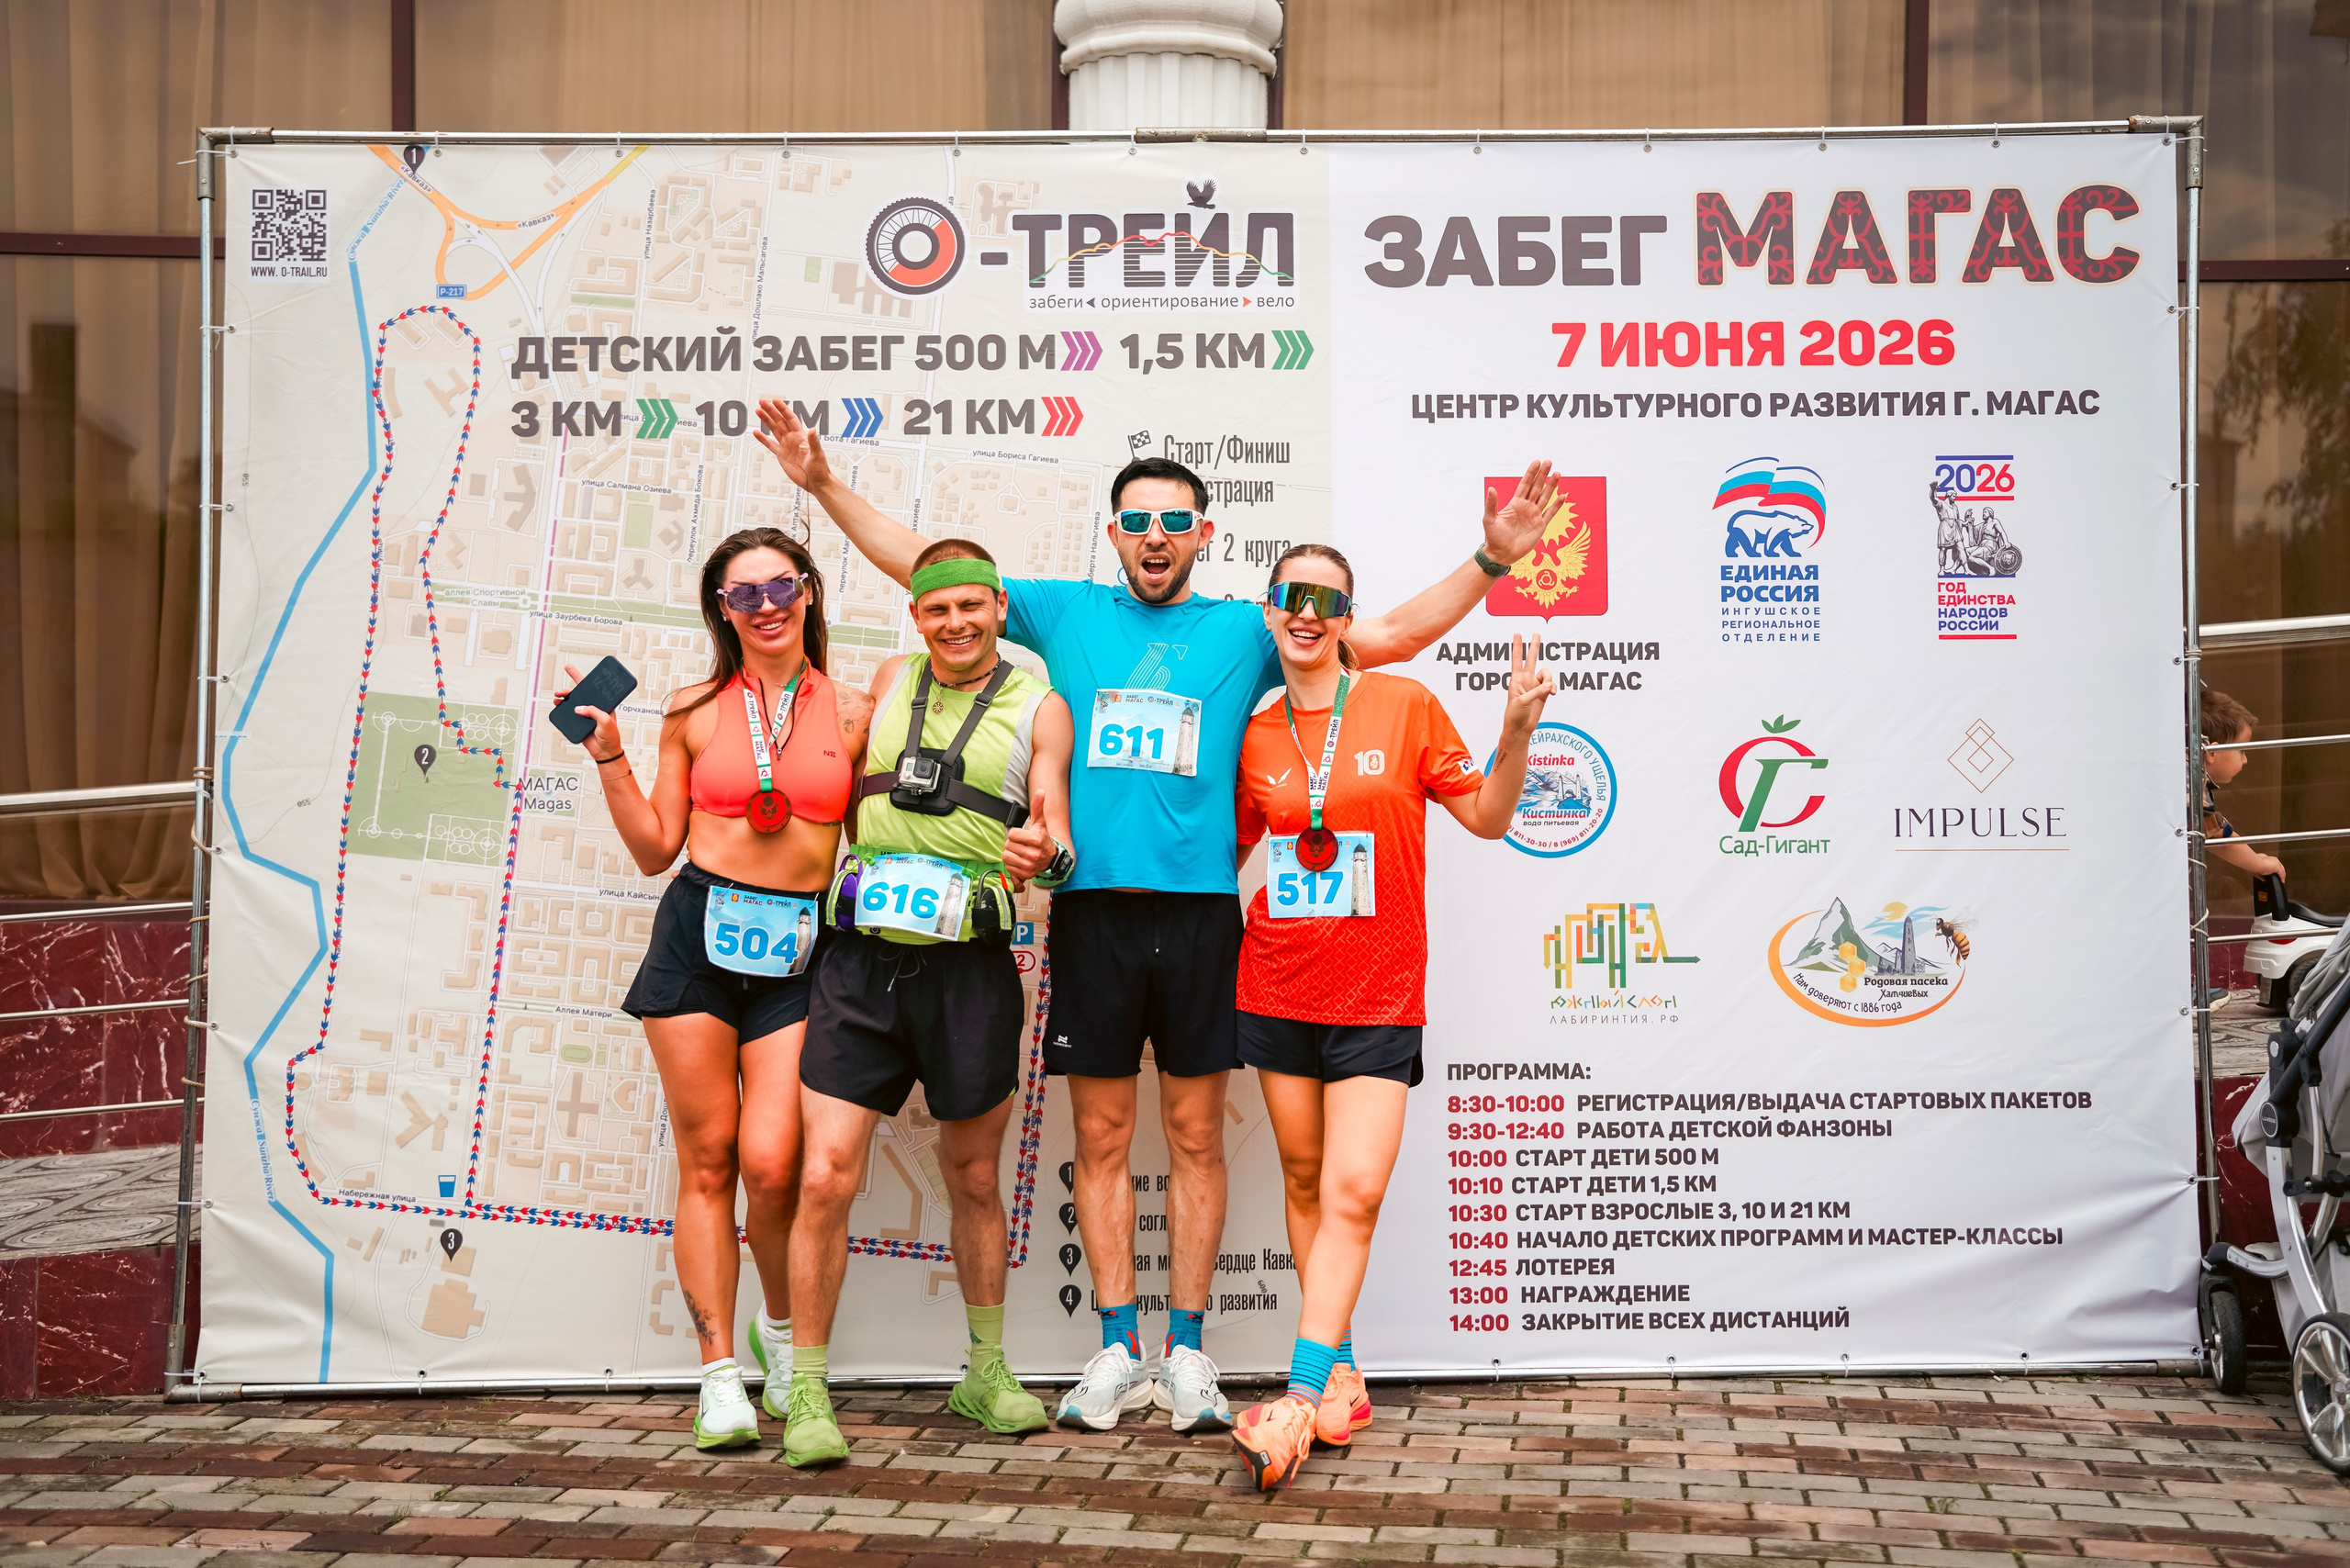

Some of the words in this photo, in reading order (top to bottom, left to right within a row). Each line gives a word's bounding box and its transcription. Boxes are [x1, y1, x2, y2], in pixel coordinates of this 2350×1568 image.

[411, 148, 417, 164] 1
[518, 212, 555, 230] «Кавказ»
[645, 189, 656, 235] Назарбаева
[1364, 215, 1668, 287] ЗАБЕГ
[1695, 185, 2140, 286] МАГАС
[251, 267, 278, 277] WWW.
[1029, 295, 1083, 309] забеги
[1102, 296, 1238, 310] ориентирование
[1257, 296, 1294, 308] вело
[511, 326, 741, 379] ДЕТСКИЙ
[753, 335, 905, 372] ЗАБЕГ
[915, 334, 1006, 371] 500
[1019, 334, 1055, 371] М
[1551, 322, 1586, 367] 7
[1600, 321, 1785, 367] ИЮНЯ
[1800, 319, 1955, 366] 2026
[1120, 333, 1184, 376] 1,5
[1196, 333, 1264, 370] КМ
[1412, 394, 1520, 423] ЦЕНТР
[1527, 392, 1762, 419] КУЛЬТУРНОГО
[1770, 391, 1944, 417] РАЗВИТИЯ
[1954, 391, 1979, 416] Г.
[1987, 389, 2099, 416] МАГАС
[511, 401, 540, 437] 3
[553, 401, 621, 436] КМ
[695, 400, 747, 436] 10
[904, 399, 952, 435] 21
[966, 399, 1035, 435] КМ
[973, 450, 995, 459] улица
[998, 451, 1026, 461] Бориса
[1028, 454, 1058, 464] Гагиева
[581, 479, 605, 489] улица
[607, 481, 642, 492] Салмана
[643, 485, 672, 494] Озиева
[694, 465, 704, 493] Бокова
[1935, 464, 2015, 493] 2026
[692, 494, 701, 524] Ахмеда
[1091, 511, 1101, 553] Нальгиева
[1224, 532, 1235, 562] 2
[1720, 565, 1818, 583] ЕДИНАЯ
[1720, 585, 1819, 602] РОССИЯ
[1938, 582, 1966, 594] ГОД
[1721, 607, 1820, 615] ИНГУШСКОЕ
[1938, 595, 2016, 607] ЕДИНСТВА
[530, 610, 553, 620] улица
[554, 611, 592, 623] Заурбека
[594, 615, 623, 626] Борова
[1938, 608, 2009, 619] НАРОДОВ
[1721, 620, 1820, 629] РЕГИОНАЛЬНОЕ
[1938, 621, 1999, 631] РОССИИ
[1721, 633, 1820, 643] ОТДЕЛЕНИЕ
[1456, 672, 1512, 690] ГОРО
[1560, 672, 1641, 690] МАГАС
[1099, 723, 1164, 759] 611
[421, 747, 429, 765] 2
[1353, 749, 1385, 776] 10
[1589, 757, 1606, 801] УЩЕЛЬЯ
[524, 798, 572, 812] Magas
[1522, 808, 1587, 819] Кистинка
[1895, 807, 2066, 837] IMPULSE
[1719, 835, 1830, 857] Сад-Гигант
[599, 889, 624, 898] улица
[1277, 871, 1343, 906] 517
[863, 881, 939, 919] 616
[1016, 924, 1029, 942] P
[715, 923, 798, 964] 504
[1863, 977, 1908, 988] Родовая
[1910, 977, 1948, 986] пасека
[1793, 972, 1808, 991] Нам
[1807, 987, 1851, 1011] доверяют
[1861, 1002, 1879, 1013] 1886
[1882, 1001, 1902, 1014] года
[555, 1006, 580, 1015] Аллея
[582, 1008, 612, 1018] Матери
[1448, 1063, 1591, 1081] ПРОГРАММА:
[1448, 1095, 1564, 1113] 8:30-10:00
[1577, 1092, 1845, 1114] РЕГИСТРАЦИЯ/ВЫДАЧА
[1850, 1092, 1986, 1109] СТАРТОВЫХ
[1991, 1092, 2092, 1108] ПАКЕТОВ
[1448, 1122, 1564, 1140] 9:30-12:40
[1577, 1121, 1664, 1138] РАБОТА
[1668, 1115, 1772, 1141] ДЕТСКОЙ
[1776, 1119, 1892, 1137] ФАНЗОНЫ
[1448, 1149, 1507, 1167] 10:00
[1516, 1149, 1587, 1167] СТАРТ
[1591, 1148, 1650, 1170] ДЕТИ
[1655, 1148, 1696, 1165] 500
[1702, 1148, 1719, 1164] М
[1068, 1165, 1073, 1182] 1
[1448, 1177, 1503, 1194] 10:10
[1511, 1176, 1583, 1194] СТАРТ
[1587, 1176, 1646, 1196] ДЕТИ
[1651, 1175, 1679, 1195] 1,5
[1684, 1175, 1717, 1193] КМ
[339, 1189, 390, 1201] Набережная
[392, 1194, 416, 1204] улица
[1068, 1206, 1075, 1224] 2
[1448, 1204, 1507, 1222] 10:30
[1516, 1204, 1587, 1221] СТАРТ
[1591, 1203, 1714, 1220] ВЗРОСЛЫЕ
[1718, 1203, 1738, 1222] 3,
[1742, 1202, 1766, 1219] 10
[1771, 1202, 1785, 1218] И
[1790, 1202, 1813, 1218] 21
[1818, 1202, 1851, 1218] КМ
[448, 1232, 455, 1249] 3
[1449, 1232, 1508, 1249] 10:40
[1516, 1230, 1607, 1249] НАЧАЛО
[1612, 1229, 1717, 1250] ДЕТСКИХ
[1721, 1228, 1843, 1247] ПРОГРАММ
[1848, 1228, 1863, 1245] И
[1868, 1227, 2063, 1245] МАСТЕР-КЛАССЫ
[1067, 1248, 1073, 1265] 3
[1449, 1260, 1506, 1277] 12:45
[1515, 1259, 1615, 1276] ЛОТЕРЕЯ
[1065, 1289, 1073, 1305] 4
[1220, 1293, 1277, 1316] развития
[1449, 1287, 1508, 1305] 13:00
[1521, 1284, 1690, 1305] НАГРАЖДЕНИЕ
[1449, 1315, 1509, 1332] 14:00
[1522, 1313, 1644, 1331] ЗАКРЫТИЕ
[1649, 1312, 1706, 1329] ВСЕХ
[1710, 1306, 1850, 1332] ДИСТАНЦИЙ
